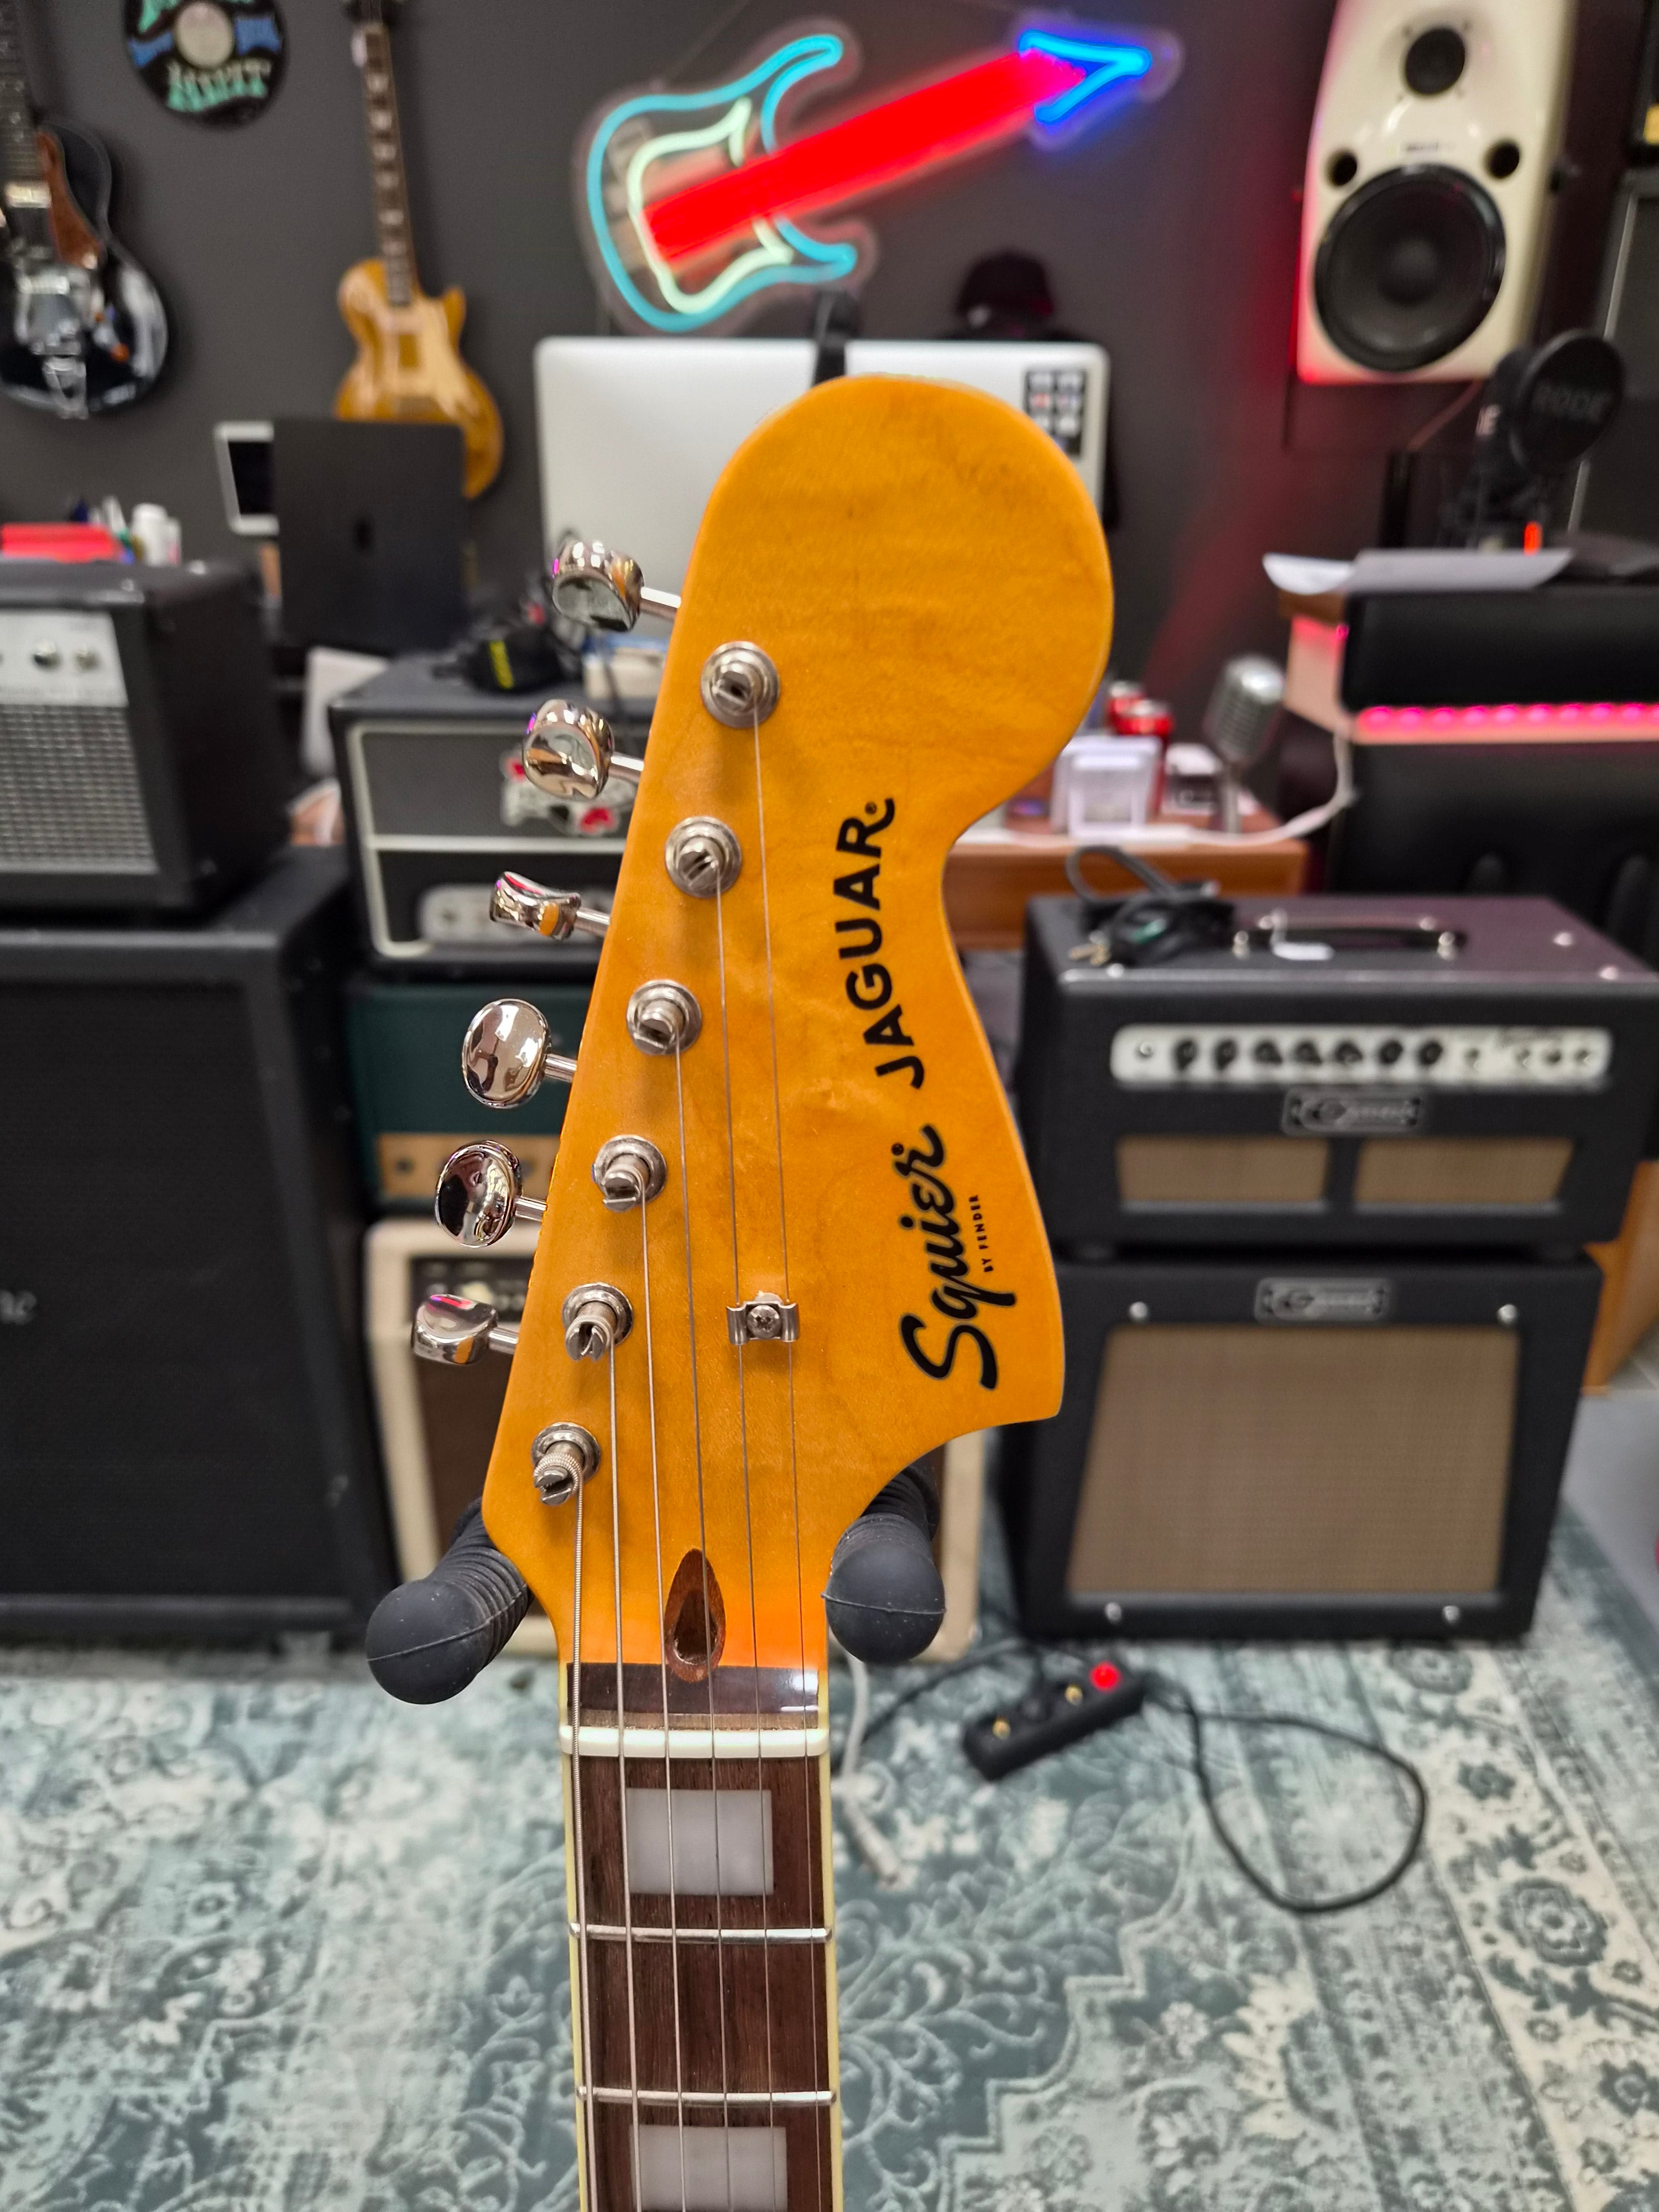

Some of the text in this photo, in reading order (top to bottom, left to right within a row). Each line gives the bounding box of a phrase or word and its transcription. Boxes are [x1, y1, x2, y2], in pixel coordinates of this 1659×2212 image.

[833, 798, 925, 1089] JAGUAR
[893, 1124, 1016, 1390] Squier
[968, 1195, 994, 1273] BY FENDER
